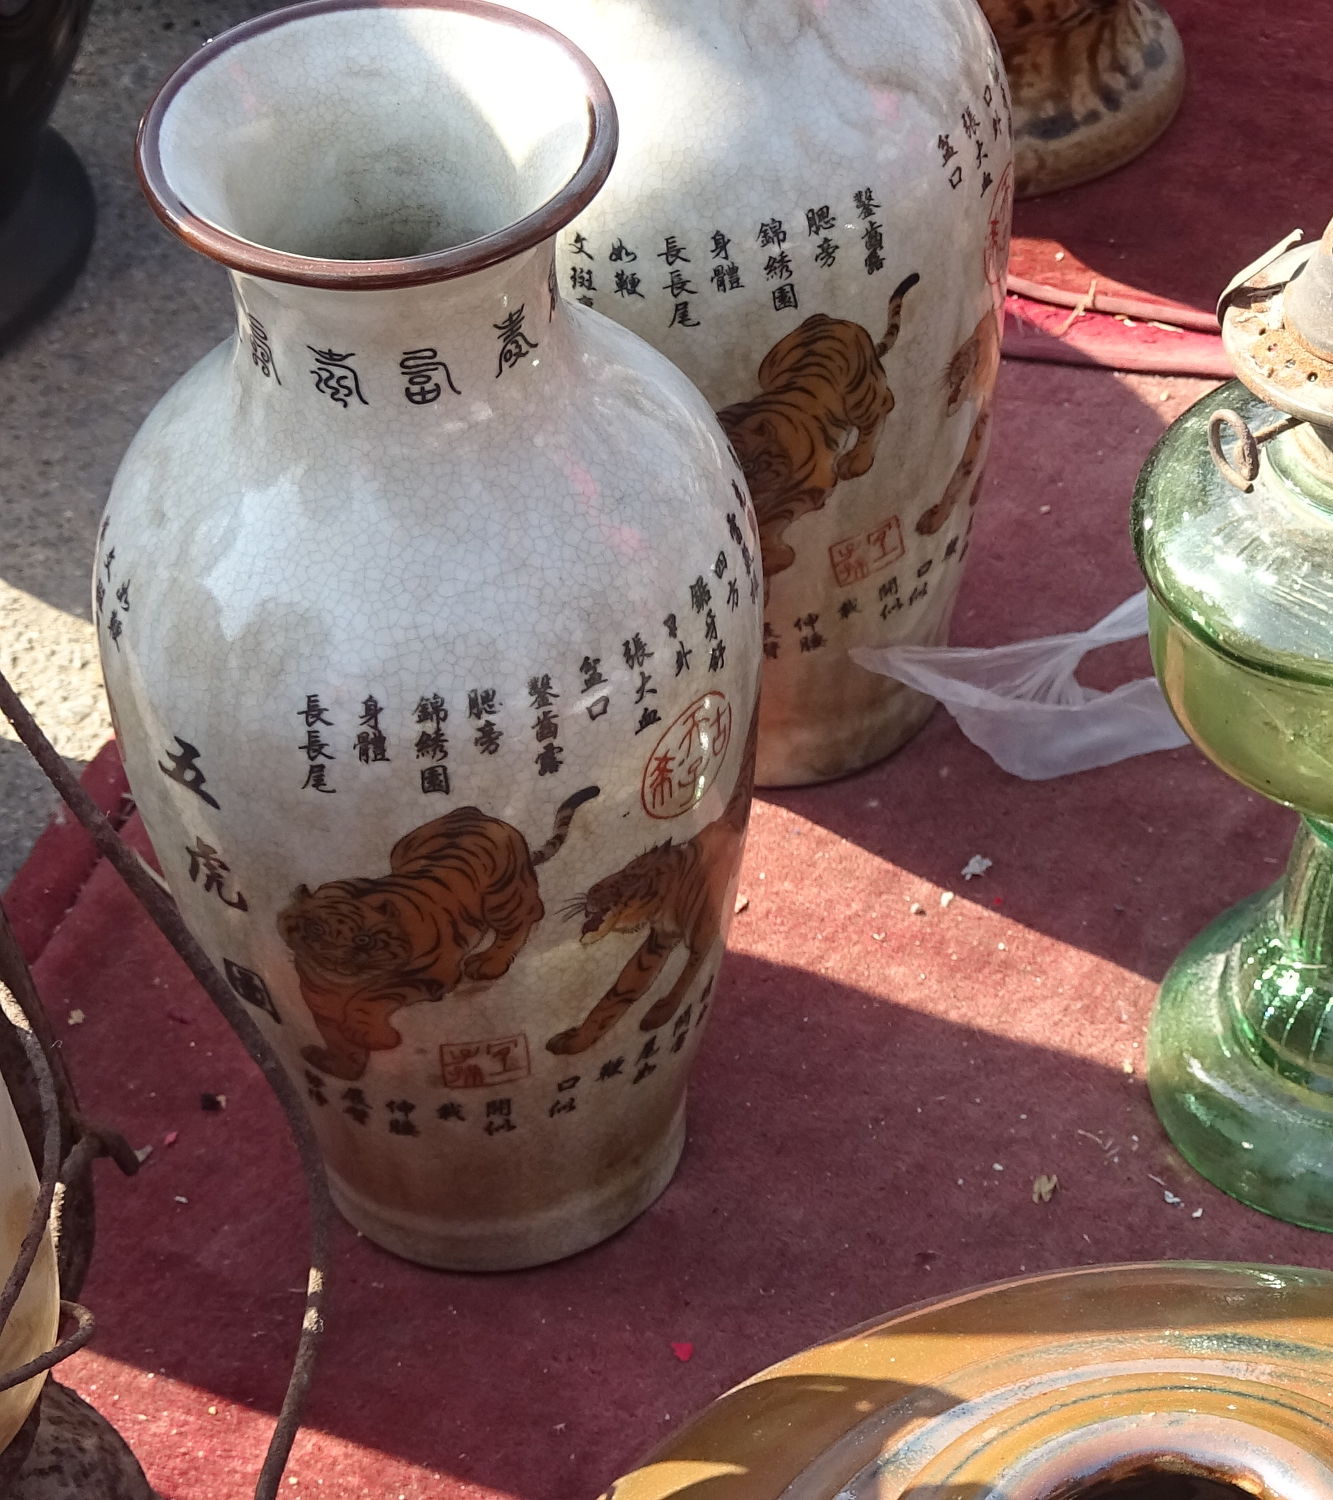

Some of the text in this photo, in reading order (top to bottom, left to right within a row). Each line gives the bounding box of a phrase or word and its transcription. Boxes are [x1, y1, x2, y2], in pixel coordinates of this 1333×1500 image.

[608, 238, 645, 299] 如鞭
[657, 236, 701, 328] 長長尾
[709, 230, 745, 295] 身體
[297, 694, 337, 794] 長長尾
[353, 694, 391, 764] 身體
